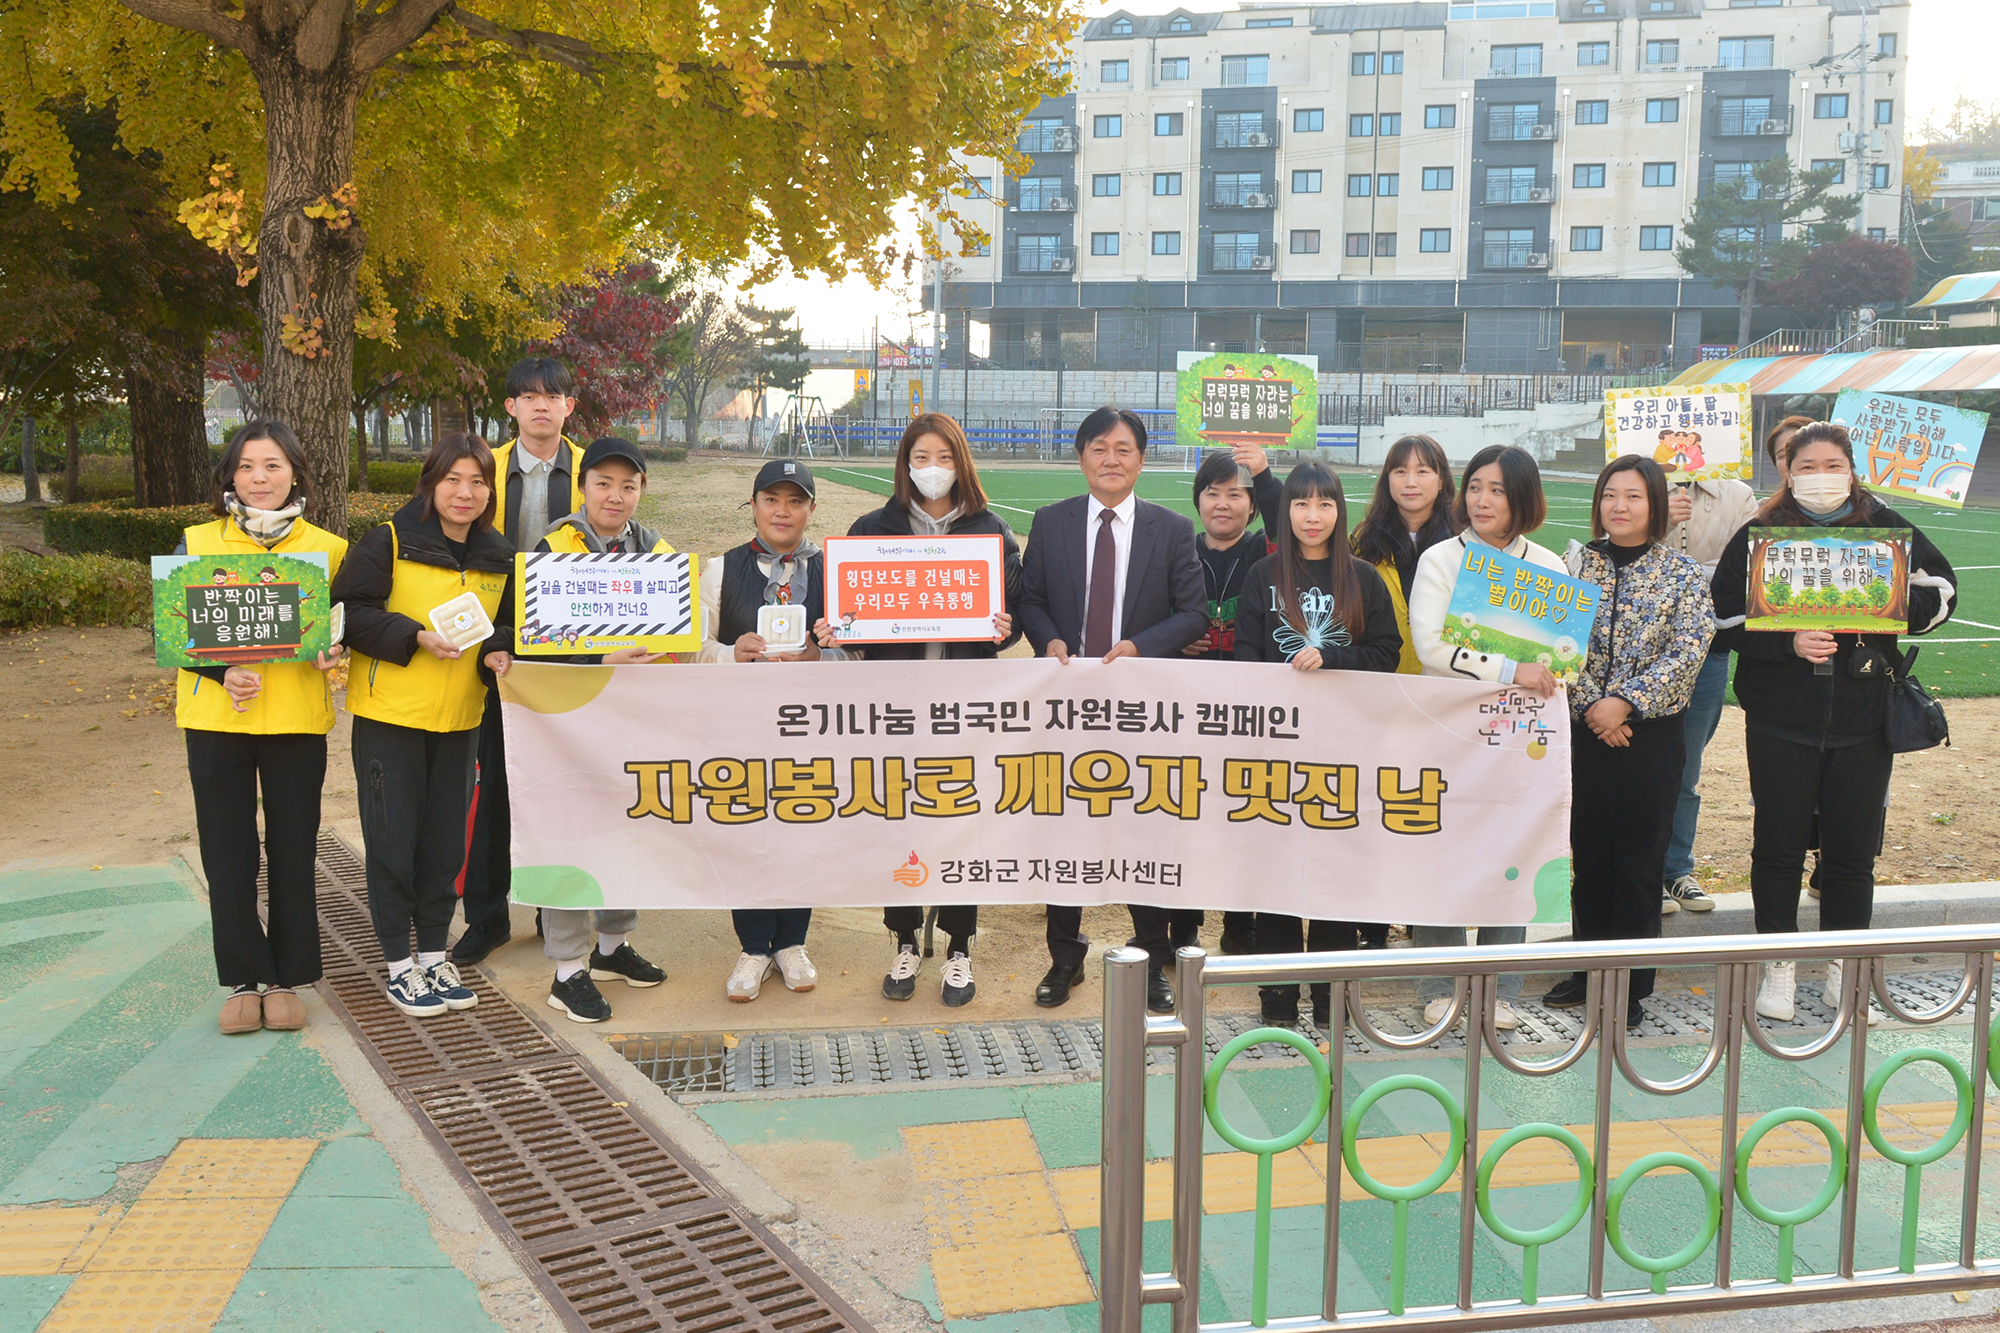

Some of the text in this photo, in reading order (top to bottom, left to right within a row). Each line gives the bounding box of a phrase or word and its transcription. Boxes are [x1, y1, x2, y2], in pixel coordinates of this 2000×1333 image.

[1206, 383, 1289, 402] 무럭무럭 자라는
[1202, 402, 1224, 418] 너의
[1229, 402, 1251, 420] 꿈을
[1633, 396, 1717, 414] 우리 아들, 딸
[1868, 397, 1942, 424] 우리는 모두
[1617, 411, 1739, 431] 건강하고 행복하길!
[1855, 412, 1946, 442] 사랑받기 위해
[1767, 547, 1888, 567] 무럭무럭 자라는
[540, 580, 678, 594] 길을 건널때는 좌우를 살피고
[846, 568, 980, 588] 횡단보도를 건널때는
[1465, 551, 1593, 612] 너는 반짝이는
[1762, 567, 1793, 585] 너의
[1803, 567, 1833, 587] 꿈을
[204, 588, 280, 607] 반짝이는
[854, 591, 974, 611] 우리모두 우측통행
[192, 604, 293, 624] 너의 미래를
[571, 602, 649, 617] 안전하게 건너요
[216, 624, 279, 642] 응원해!
[1479, 690, 1545, 717] 대한민국
[777, 698, 1300, 740] 온기나눔 범국민 자원봉사 캠페인
[1479, 719, 1556, 746] 온기나눔
[624, 750, 1447, 835] 자원봉사로 깨우자 멋진 날
[940, 858, 1183, 887] 강화군 자원봉사센터
